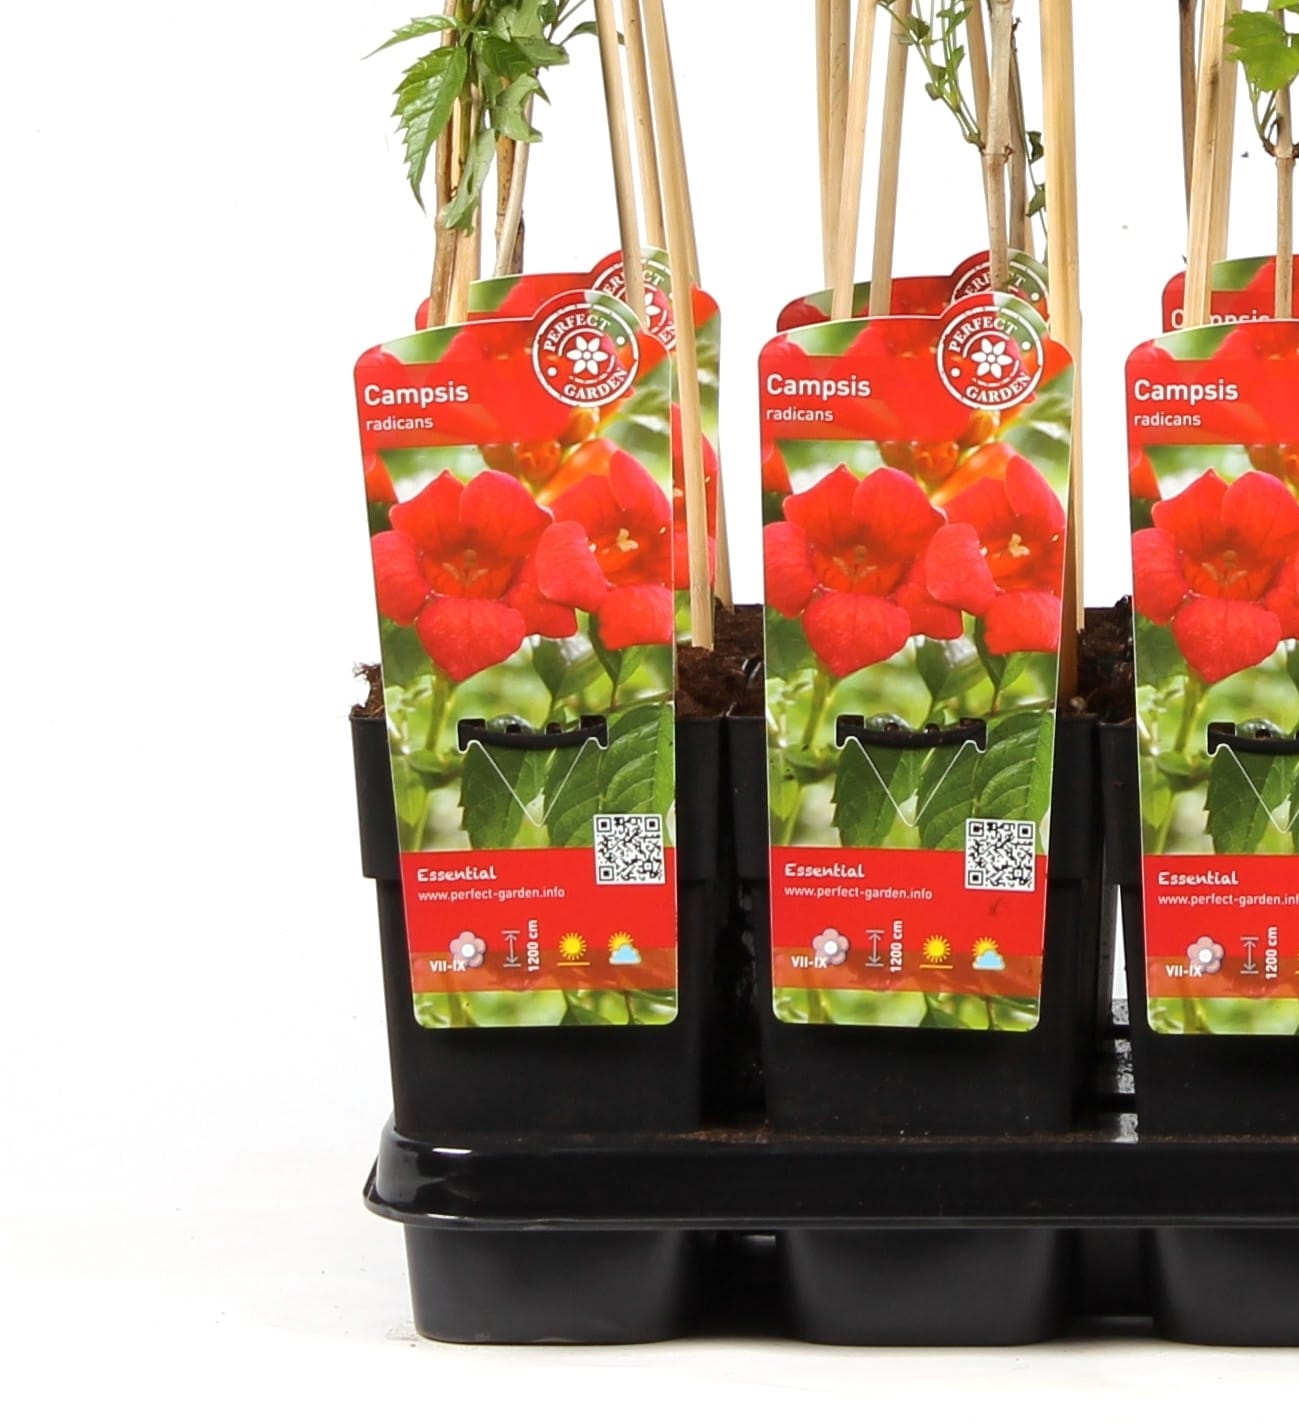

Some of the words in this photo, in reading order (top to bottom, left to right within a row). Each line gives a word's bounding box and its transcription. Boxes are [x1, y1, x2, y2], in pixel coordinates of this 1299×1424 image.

[543, 314, 611, 351] PERFECT
[949, 316, 1018, 352] PERFECT
[564, 366, 627, 400] GARDEN
[766, 374, 871, 401] Campsis
[966, 372, 1032, 403] GARDEN
[1134, 379, 1239, 405] Campsis
[363, 381, 469, 407] Campsis
[366, 416, 434, 431] radicans
[766, 407, 833, 421] radicans
[1134, 412, 1201, 426] radicans
[417, 865, 497, 882] Essential
[784, 862, 865, 879] Essential
[1158, 871, 1239, 886] Essential
[418, 886, 565, 902] www.perfect-garden.info
[784, 884, 933, 901] www.perfect-garden.info
[528, 920, 538, 939] cm
[892, 920, 903, 940] cm
[1267, 926, 1278, 946] cm
[528, 941, 540, 971] 1200
[791, 956, 828, 968] VII-IX
[890, 942, 903, 972] 1200
[1266, 948, 1278, 979] 1200
[429, 960, 467, 972] VII-IX
[1165, 965, 1203, 977] VII-IX
